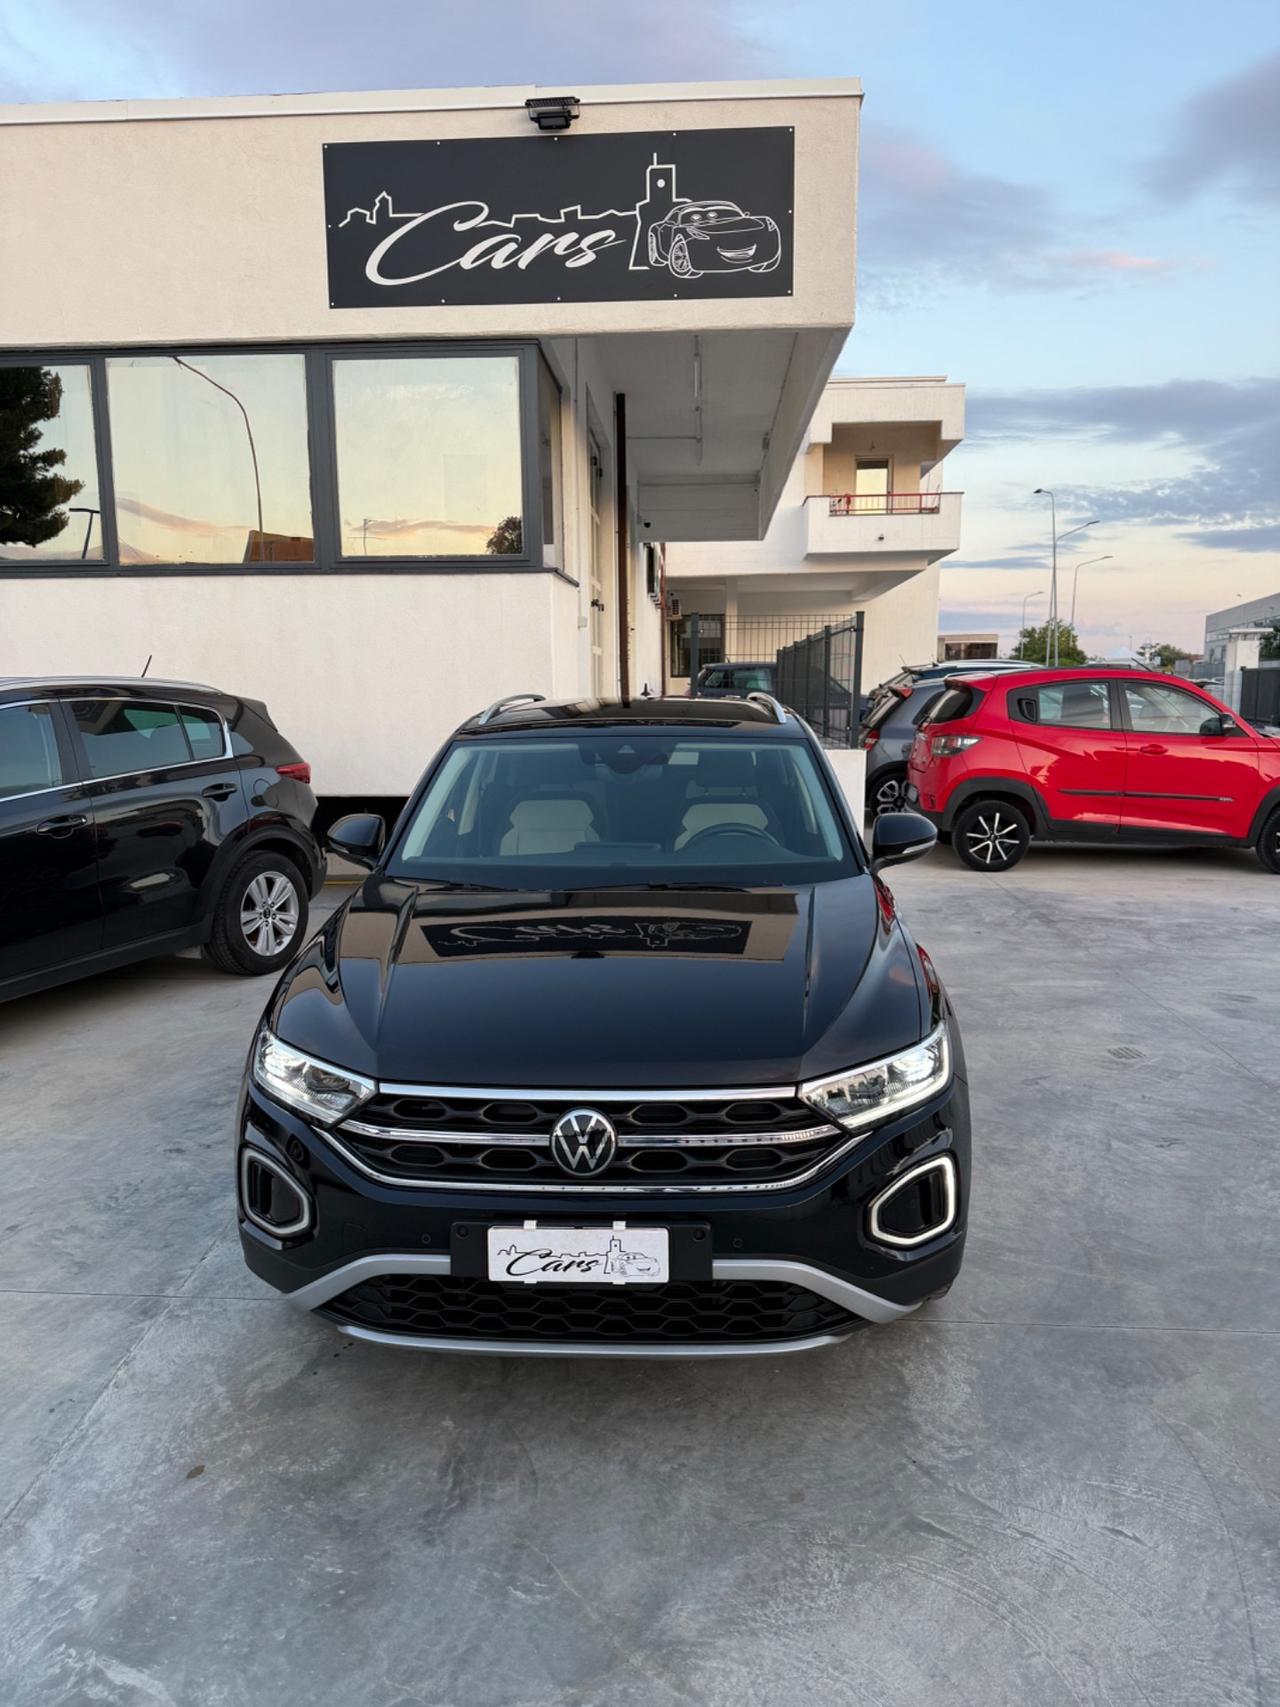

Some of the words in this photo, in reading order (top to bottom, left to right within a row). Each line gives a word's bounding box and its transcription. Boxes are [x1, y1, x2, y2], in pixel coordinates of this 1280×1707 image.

[365, 200, 626, 286] Cars
[552, 1109, 616, 1176] VW
[506, 1249, 600, 1276] Cars
